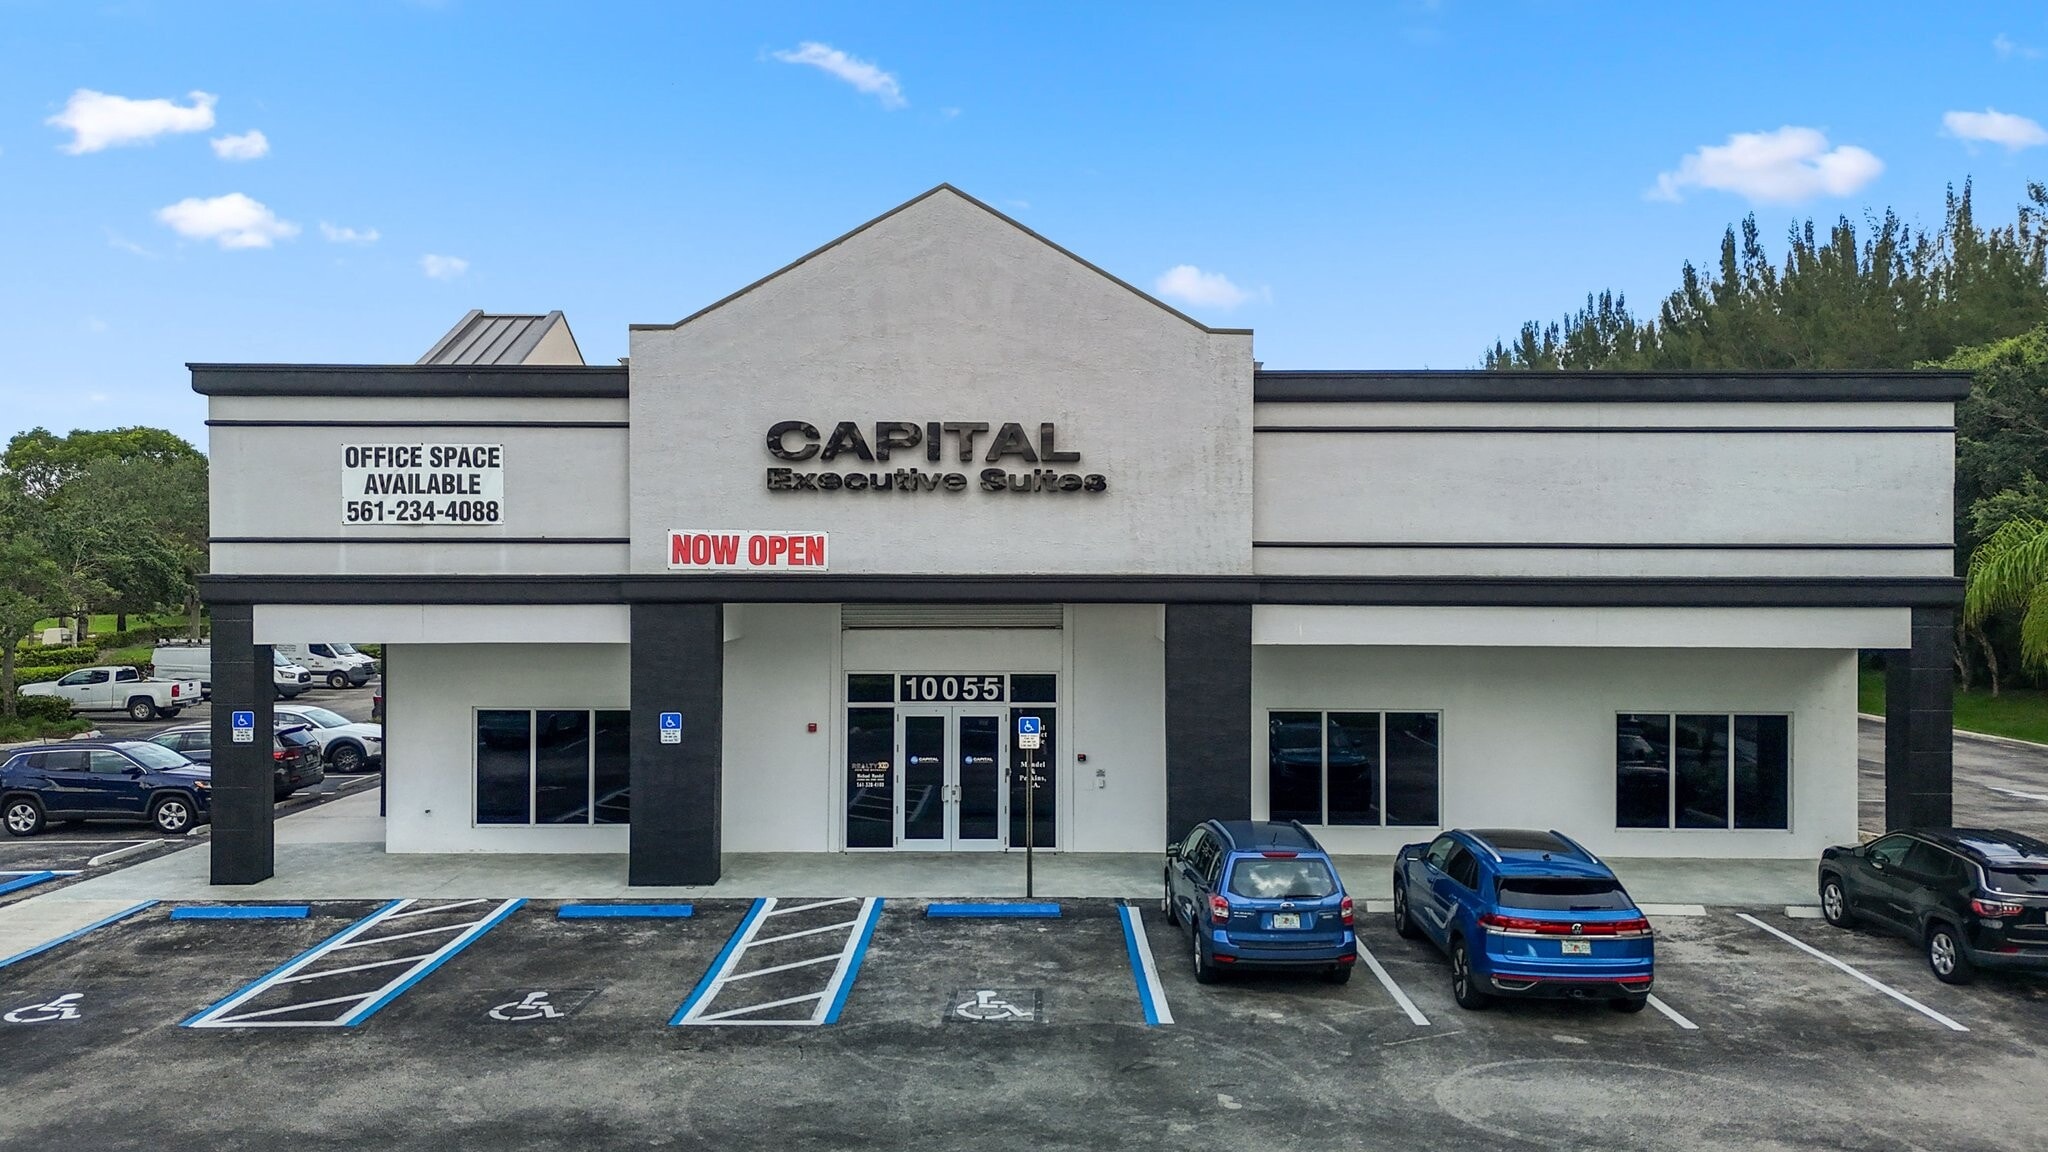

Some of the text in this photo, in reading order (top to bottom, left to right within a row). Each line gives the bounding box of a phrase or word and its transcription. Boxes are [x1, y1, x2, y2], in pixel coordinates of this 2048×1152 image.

[766, 420, 1080, 463] CAPITAL
[345, 446, 501, 468] OFFICE SPACE
[363, 473, 482, 495] AVAILABLE
[766, 467, 1108, 493] Executive Suites
[347, 500, 500, 522] 561-234-4088
[672, 534, 825, 566] NOW OPEN
[906, 677, 999, 700] 10055
